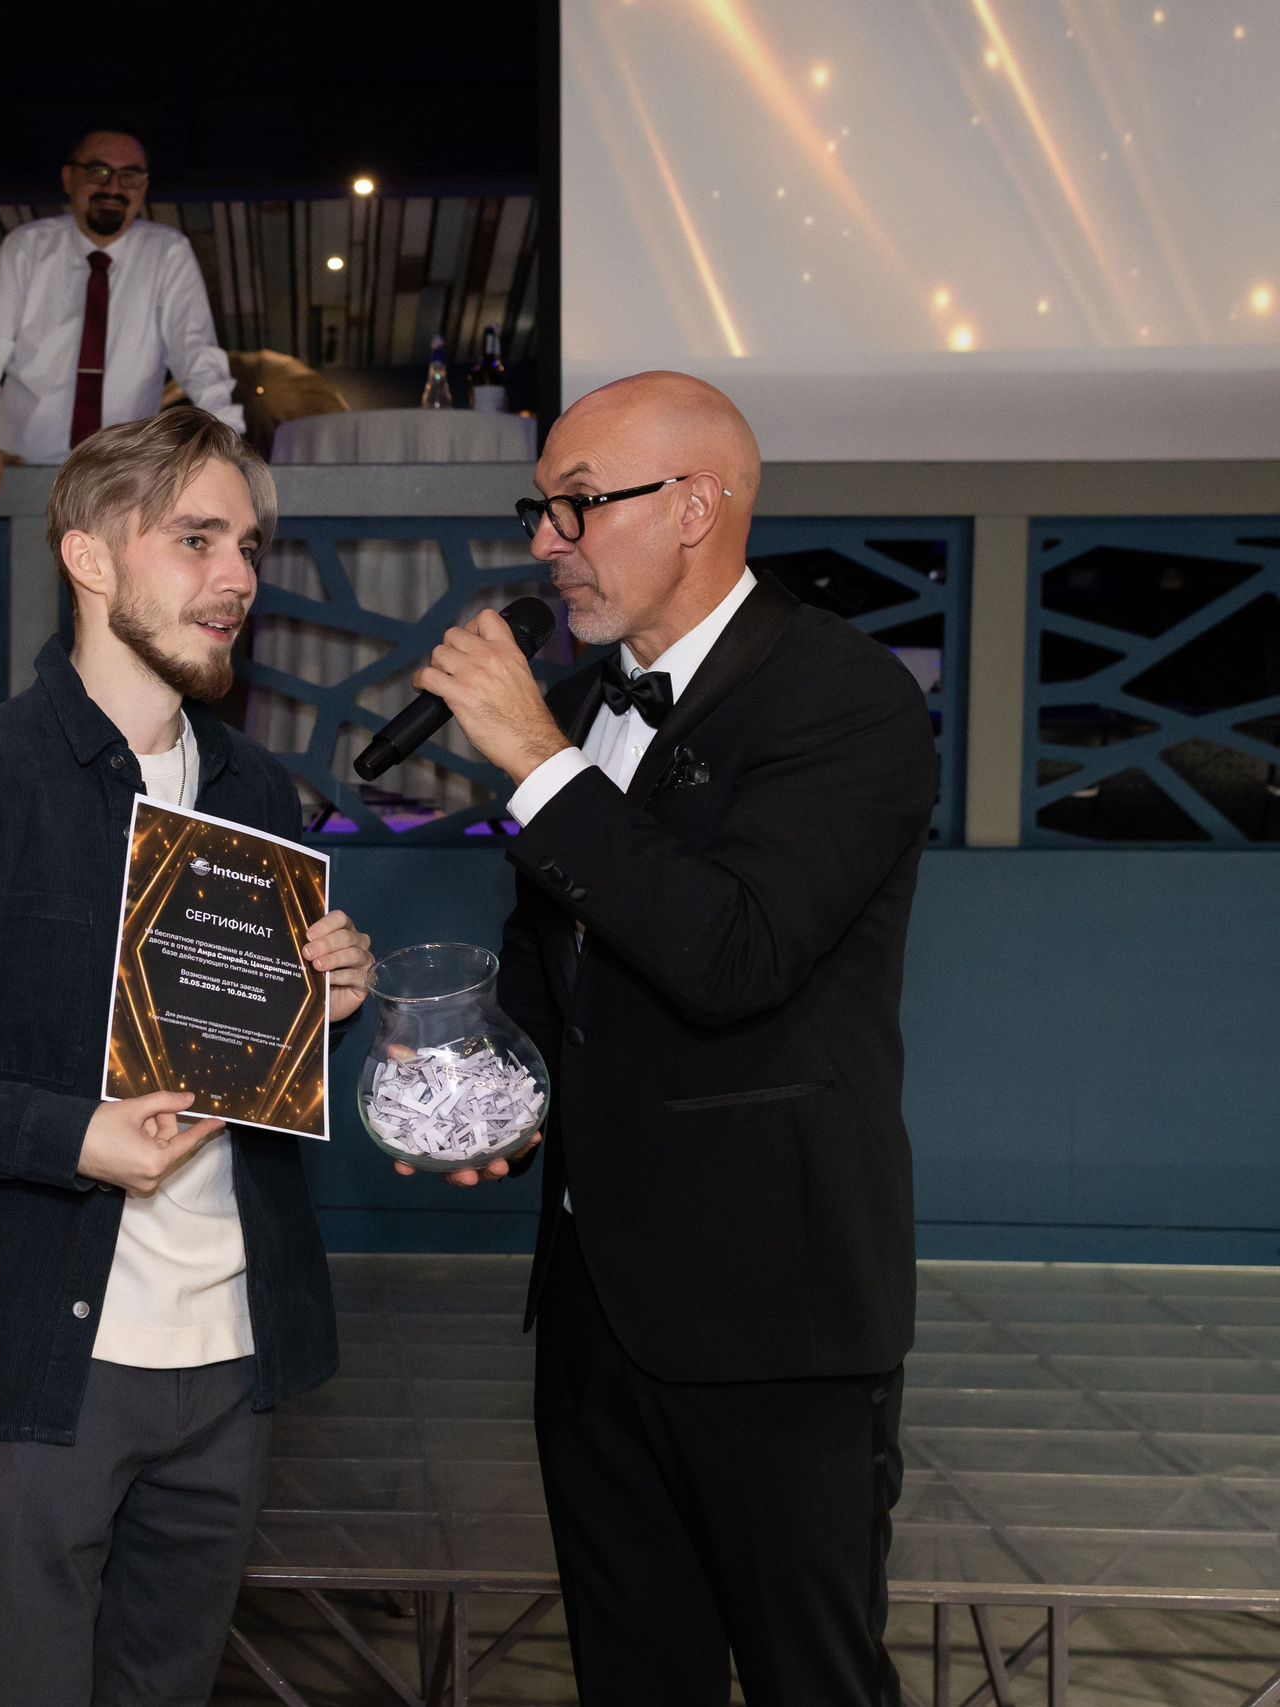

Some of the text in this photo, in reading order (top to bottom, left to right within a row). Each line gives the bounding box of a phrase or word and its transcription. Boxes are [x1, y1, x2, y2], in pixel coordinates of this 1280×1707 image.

[213, 864, 271, 889] Intourist
[185, 908, 274, 939] СЕРТИФИКАТ
[148, 936, 170, 947] двоих
[176, 943, 197, 953] отеле
[217, 952, 250, 966] Санрайз,
[292, 970, 302, 978] на
[154, 929, 195, 944] бесплатное
[195, 940, 238, 954] проживание
[244, 951, 274, 964] Абхазии,
[275, 957, 281, 965] 3
[281, 960, 298, 969] ночи
[161, 947, 179, 957] базе
[178, 952, 229, 969] действующего
[229, 964, 259, 976] питания
[264, 972, 285, 983] отеле
[179, 976, 221, 992] 25.05.2026
[226, 987, 267, 1003] 10.06.2026
[180, 968, 265, 994] Возможные даты заезда:
